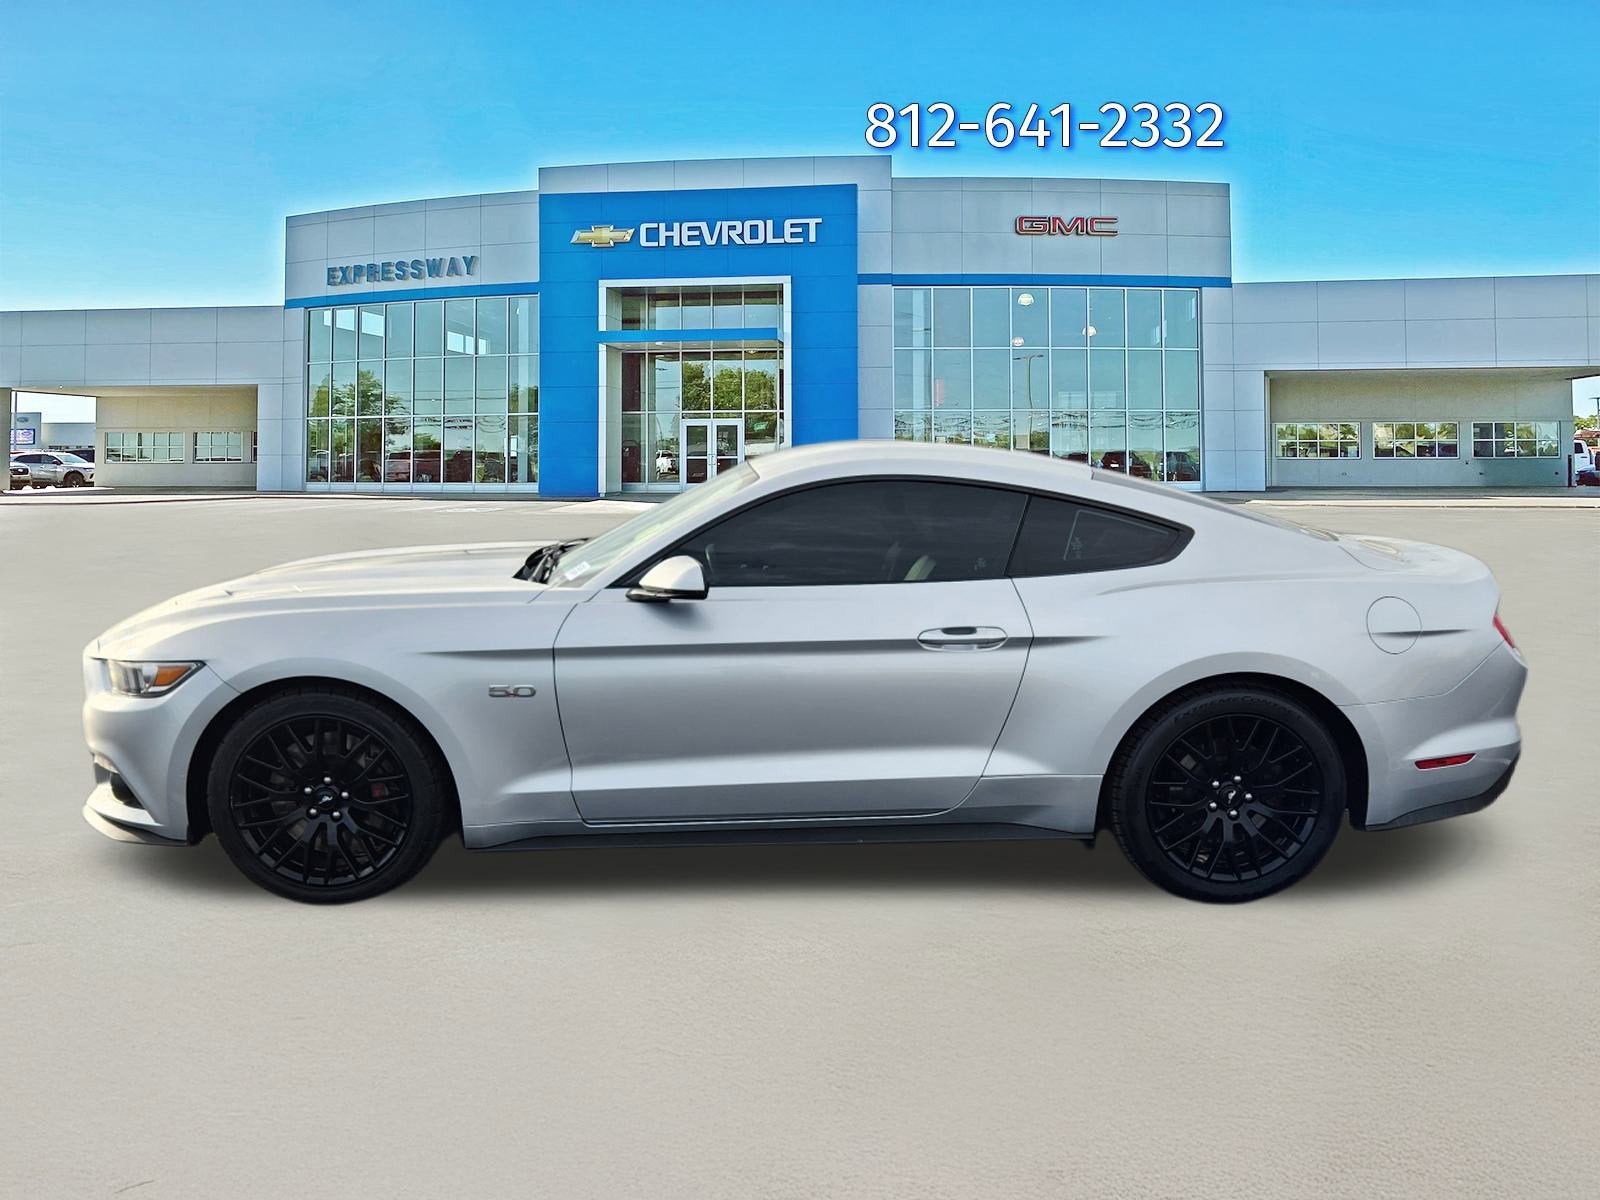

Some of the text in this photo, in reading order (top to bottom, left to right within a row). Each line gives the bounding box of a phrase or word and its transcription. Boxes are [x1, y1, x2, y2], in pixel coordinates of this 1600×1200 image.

[639, 217, 823, 248] CHEVROLET
[1015, 215, 1119, 236] GMC
[327, 255, 478, 286] EXPRESSWAY
